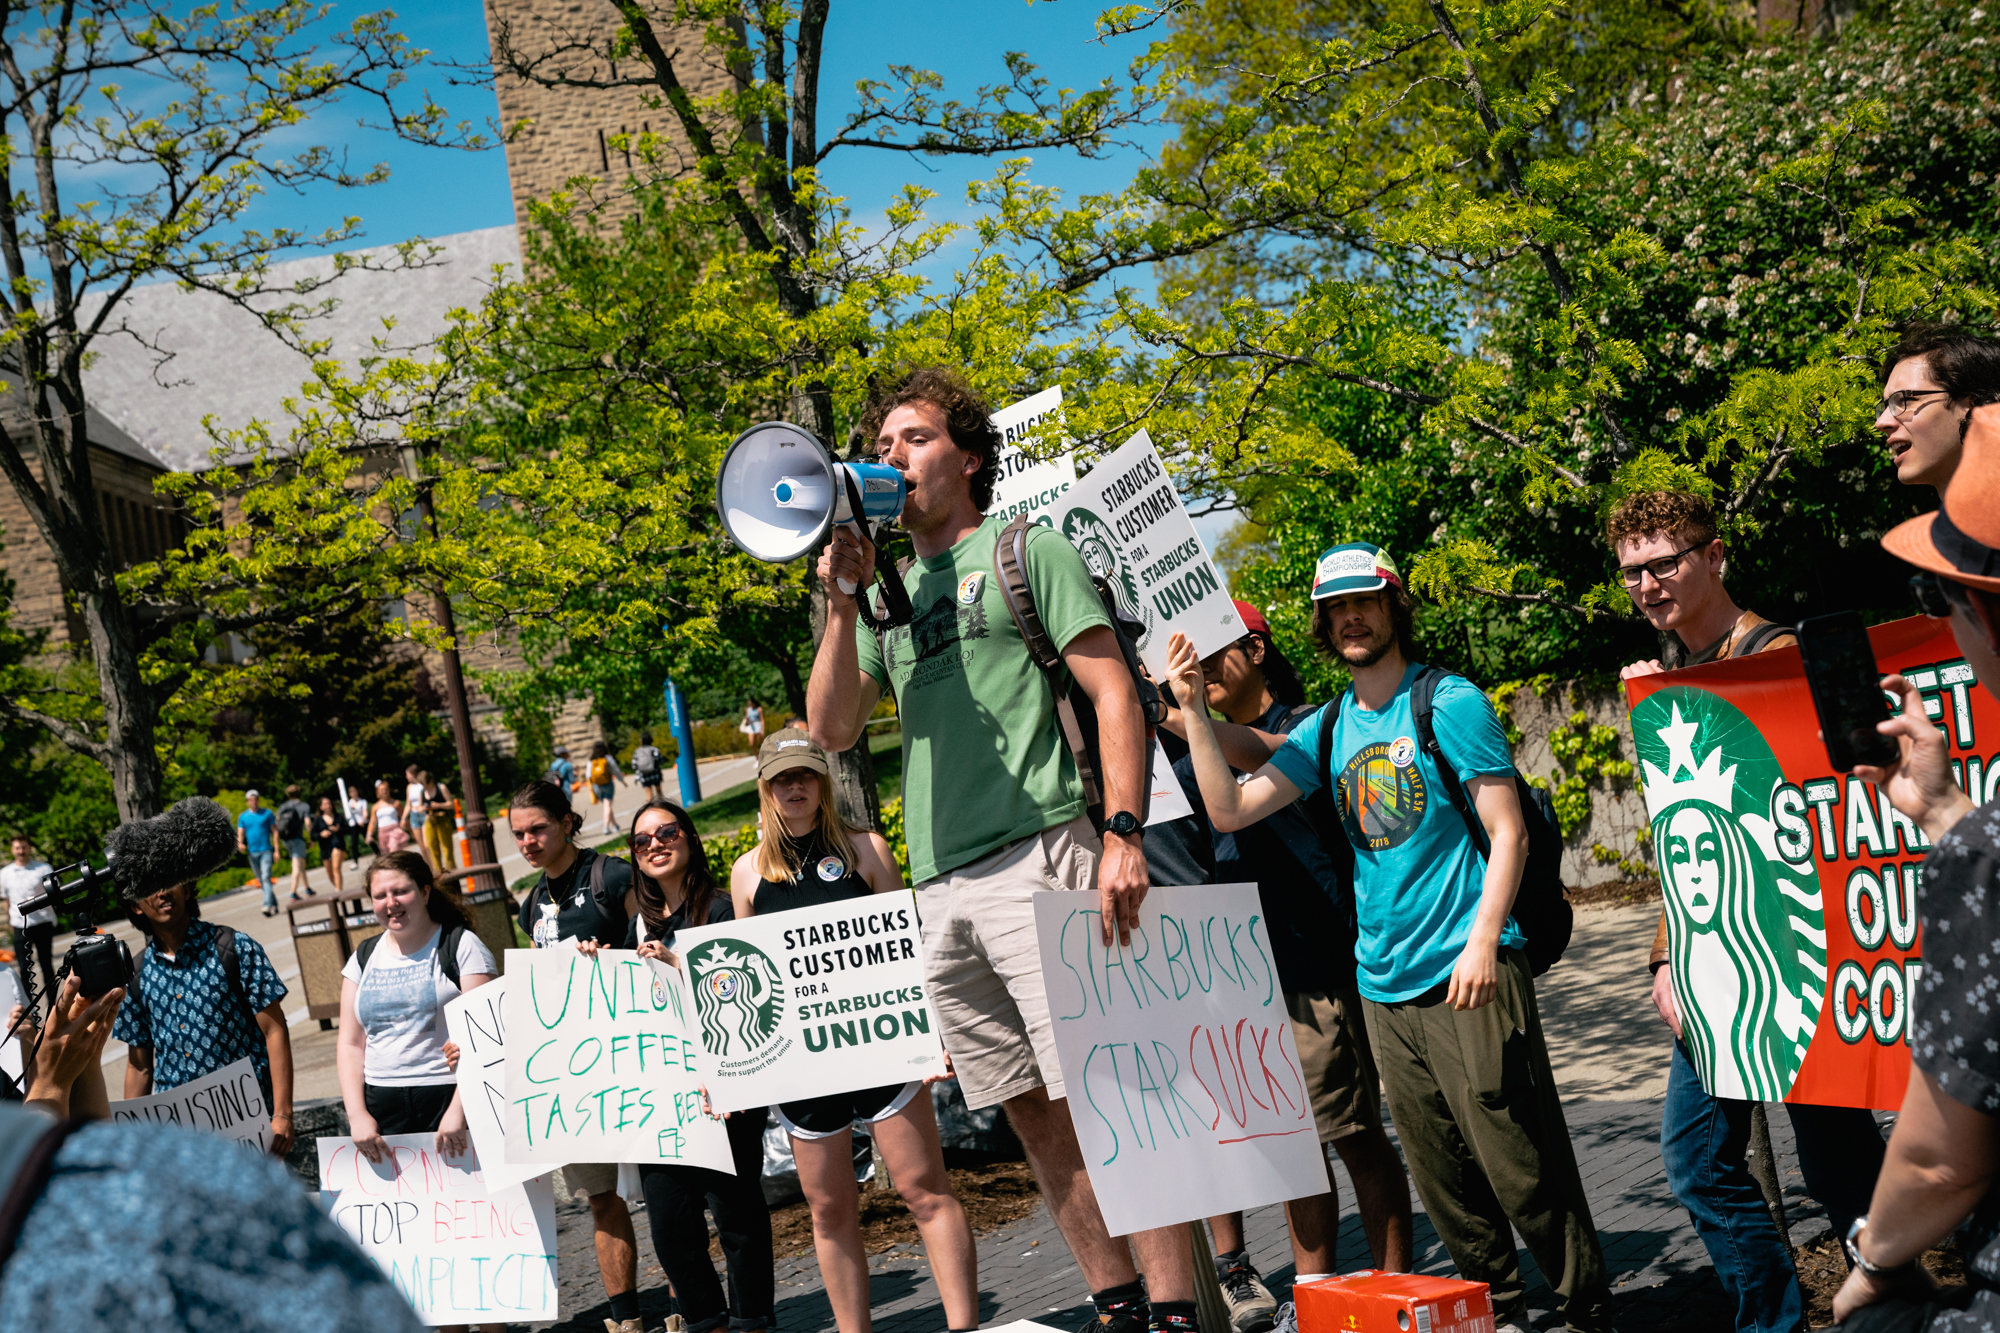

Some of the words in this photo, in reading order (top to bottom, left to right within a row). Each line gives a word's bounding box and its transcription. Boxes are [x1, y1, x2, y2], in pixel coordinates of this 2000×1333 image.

[1101, 453, 1160, 513] STARBUCKS
[1116, 484, 1177, 543] CUSTOMER
[1130, 548, 1143, 564] FOR
[1142, 544, 1150, 556] A
[1140, 537, 1200, 588] STARBUCKS
[1322, 562, 1372, 577] CHAMPIONSHIPS
[1323, 557, 1340, 569] WORLD
[1342, 555, 1372, 563] ATHLETICS
[1152, 561, 1219, 621] UNION
[955, 649, 975, 664] LOJ
[1406, 767, 1422, 790] HALF
[1413, 800, 1424, 813] 5K
[1369, 837, 1389, 847] 2018
[1847, 865, 1923, 950] OU
[783, 909, 910, 951] STARBUCKS
[789, 937, 916, 979] CUSTOMER
[1060, 908, 1273, 1021] STARBUCKS
[530, 956, 686, 1030] UNION
[794, 984, 818, 998] FOR
[821, 982, 829, 994] A
[797, 985, 924, 1021] STARBUCKS
[803, 1007, 930, 1053] UNION
[526, 1029, 697, 1084] COFFEE
[717, 1069, 737, 1077] Siren
[738, 1062, 766, 1077] support
[765, 1055, 778, 1066] the
[777, 1038, 794, 1057] union
[720, 1055, 760, 1068] Customers
[760, 1035, 785, 1059] demand
[512, 1085, 658, 1147] TASTES
[336, 1201, 419, 1245] STOP
[434, 1199, 534, 1244] BEING
